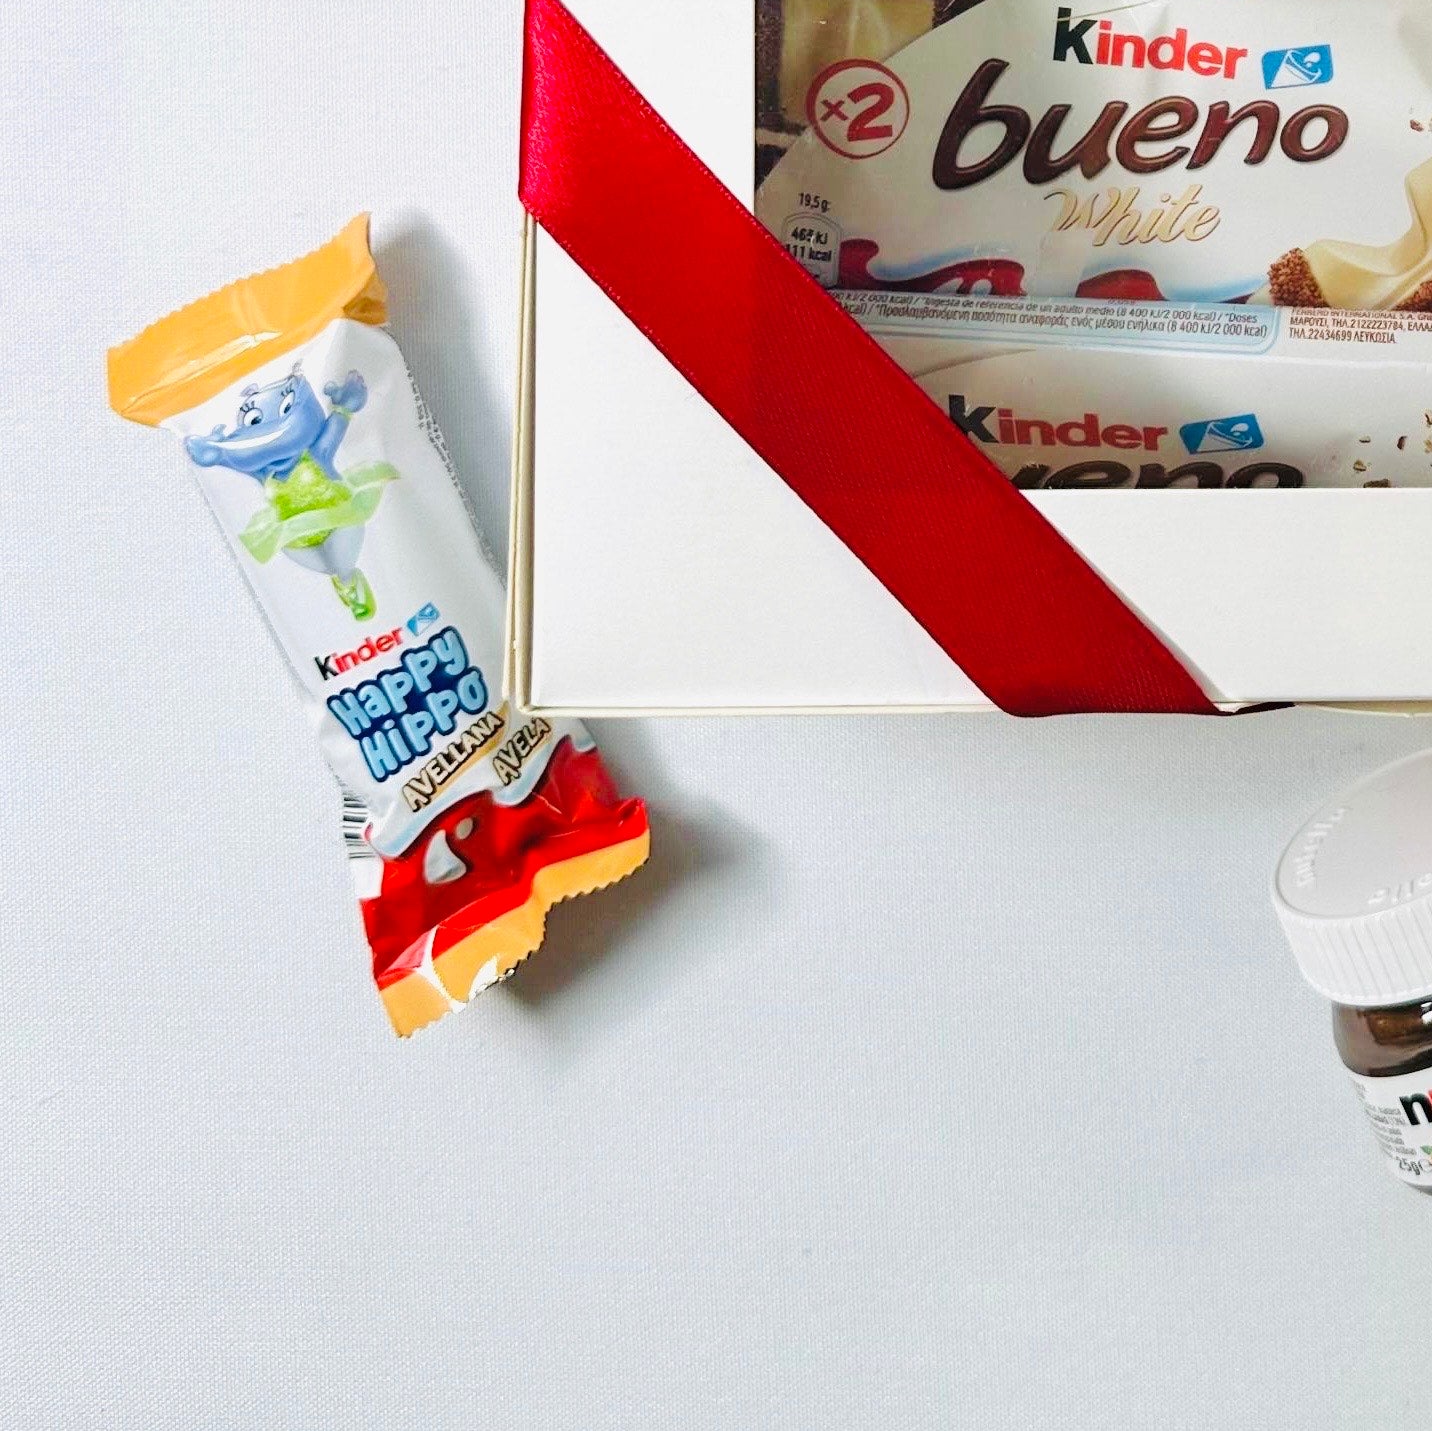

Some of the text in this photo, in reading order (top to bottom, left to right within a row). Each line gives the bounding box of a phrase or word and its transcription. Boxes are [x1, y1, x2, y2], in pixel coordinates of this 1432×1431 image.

[1053, 7, 1247, 80] kinder
[932, 58, 1349, 191] bueno
[1043, 183, 1222, 247] White
[1180, 321, 1198, 333] 400
[948, 394, 1168, 451] kinder
[313, 626, 405, 681] kinder
[401, 710, 505, 812] AVELLANA
